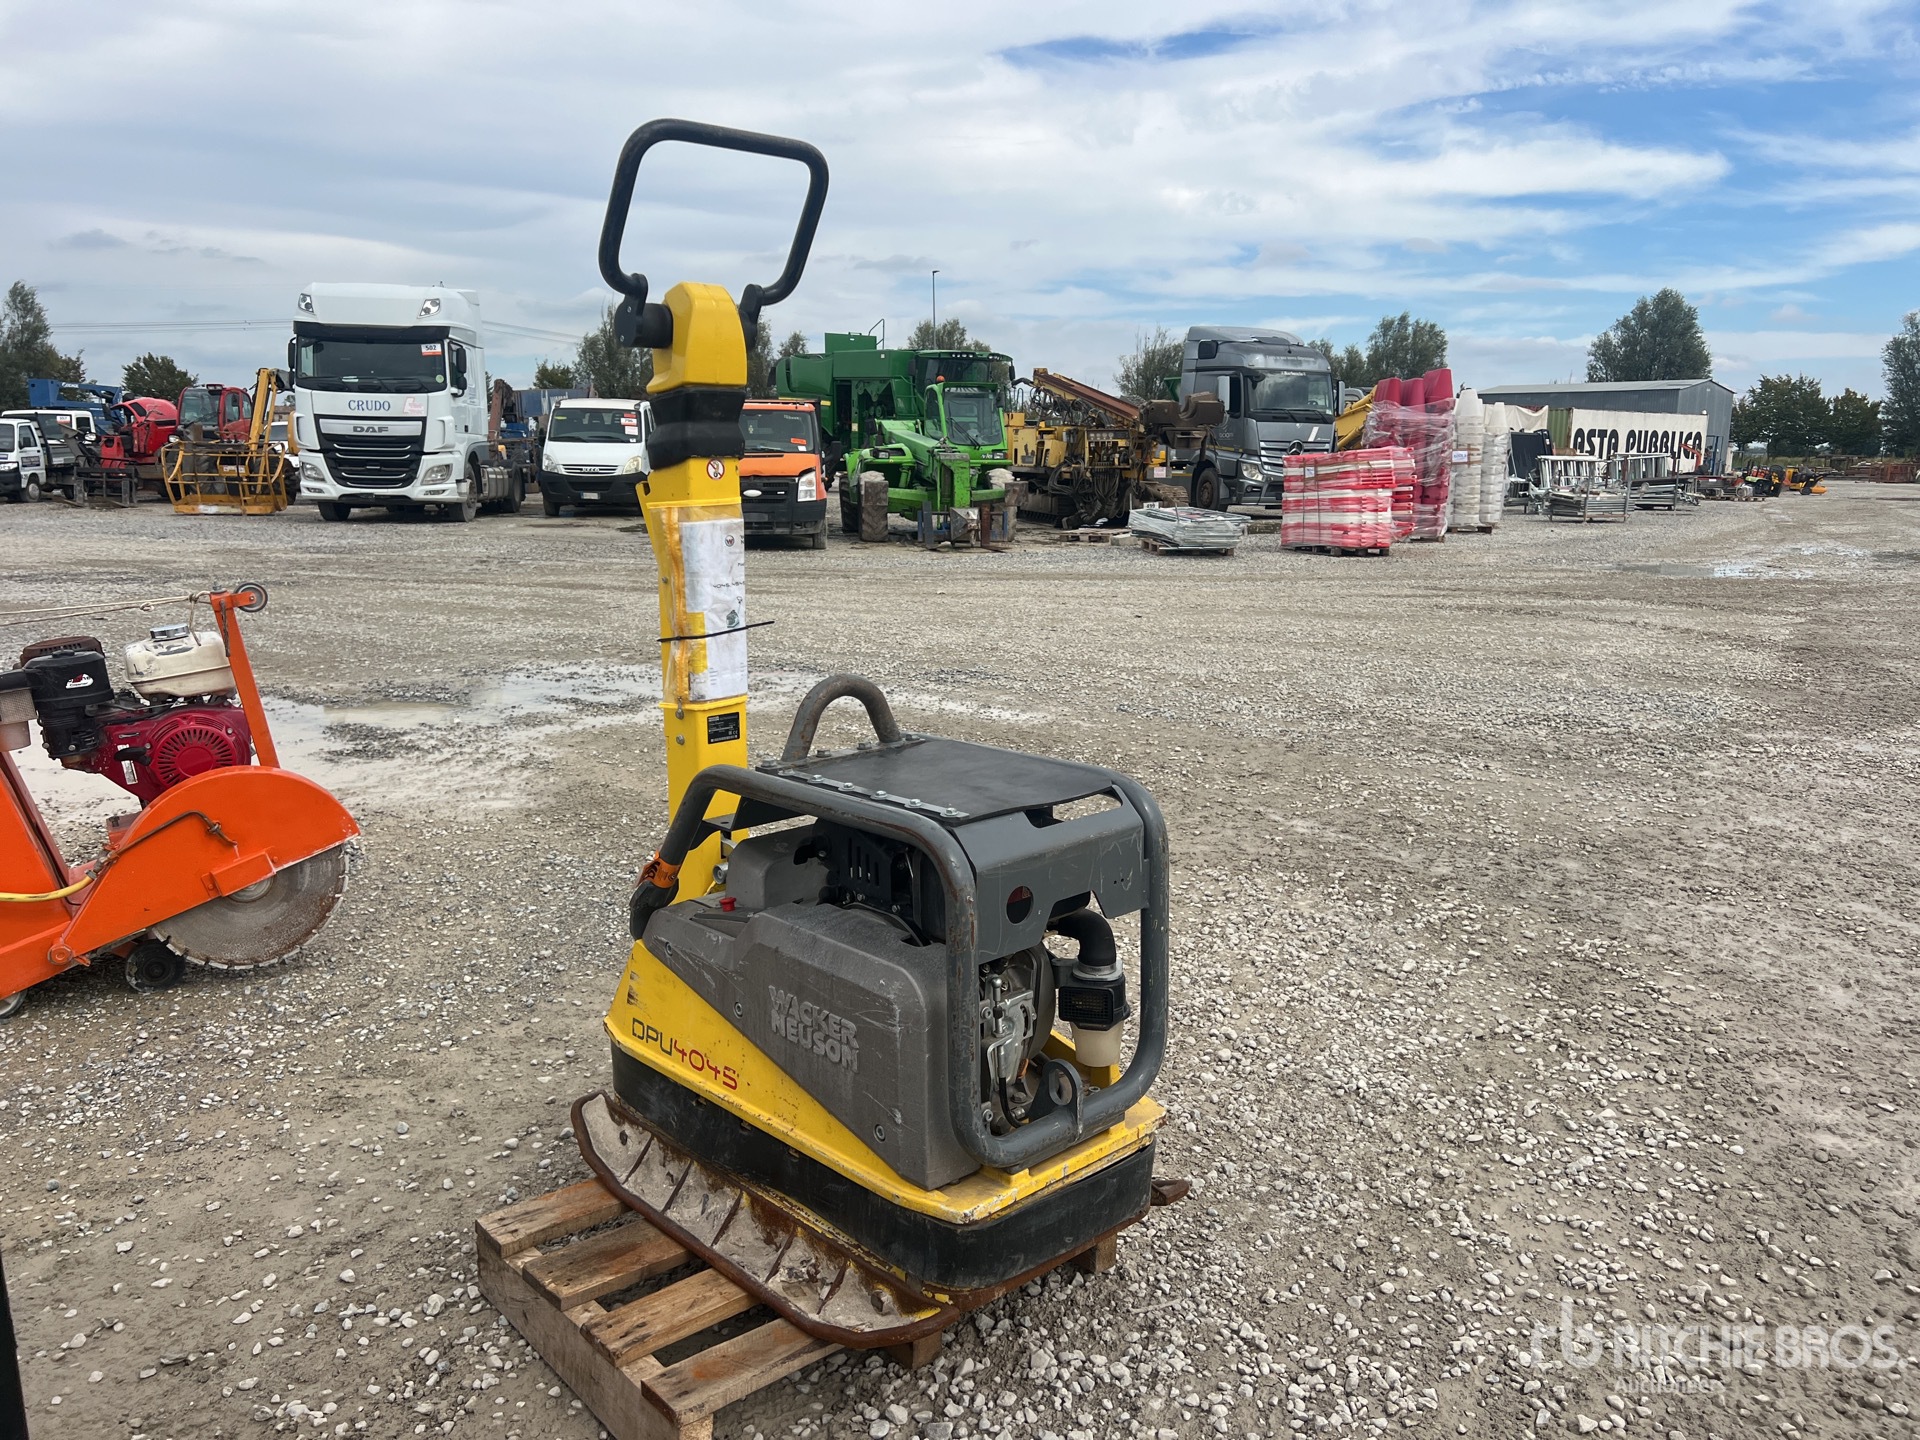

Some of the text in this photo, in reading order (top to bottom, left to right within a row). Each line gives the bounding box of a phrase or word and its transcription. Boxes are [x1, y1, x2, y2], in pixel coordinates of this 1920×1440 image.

[348, 399, 391, 412] CRUDO
[352, 425, 389, 433] DAF
[1573, 427, 1703, 460] ASTA PUBBLICA
[769, 985, 860, 1049] WACKER
[770, 1008, 860, 1074] NEUSON
[631, 1016, 738, 1091] DPU4045
